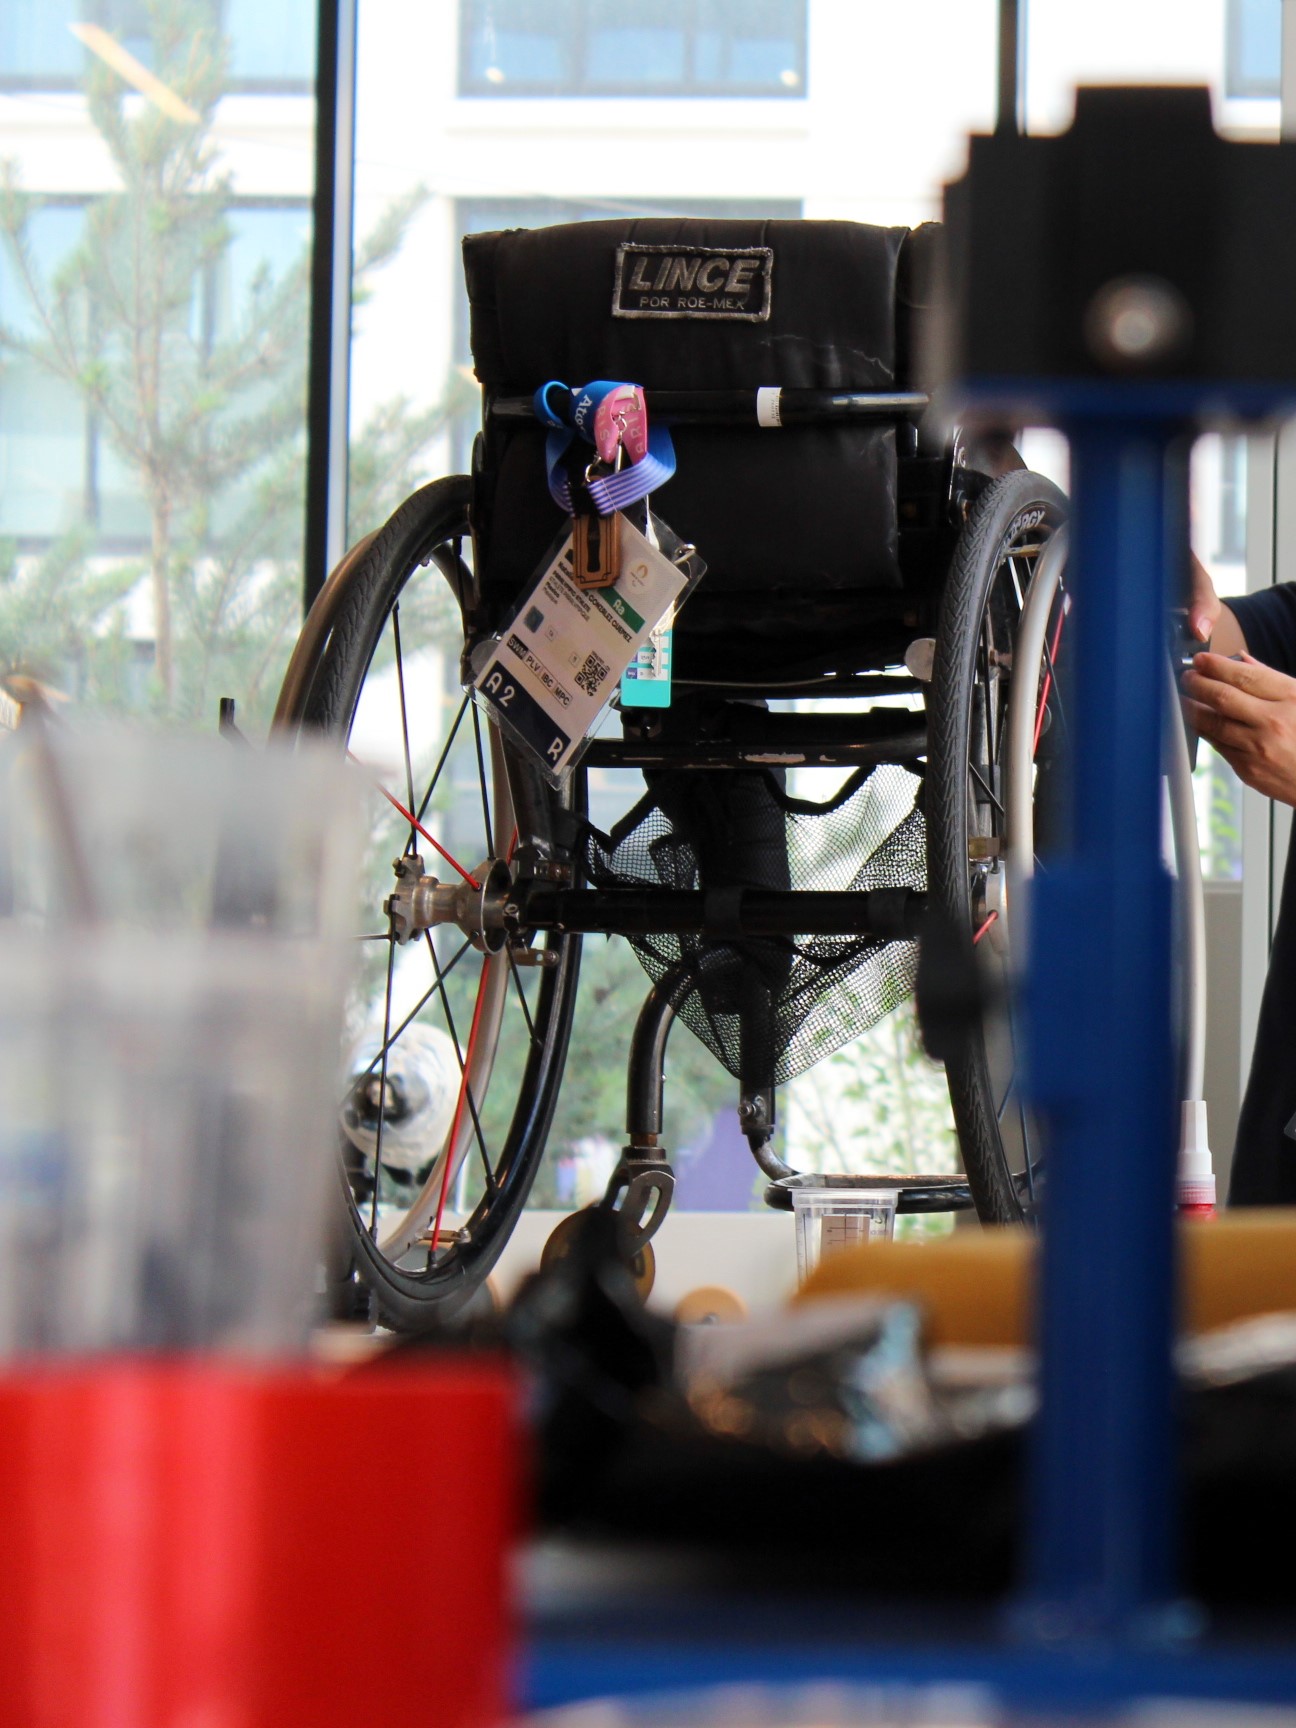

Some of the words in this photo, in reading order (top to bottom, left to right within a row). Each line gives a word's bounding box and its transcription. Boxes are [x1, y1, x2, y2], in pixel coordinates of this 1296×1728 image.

[629, 256, 760, 292] LINCE
[639, 296, 670, 308] POR
[677, 297, 745, 310] ROE-MEX
[508, 638, 527, 657] SWM
[526, 655, 541, 672] PLV
[541, 672, 554, 688] IBC
[554, 687, 570, 706] MPC
[546, 736, 564, 761] R
